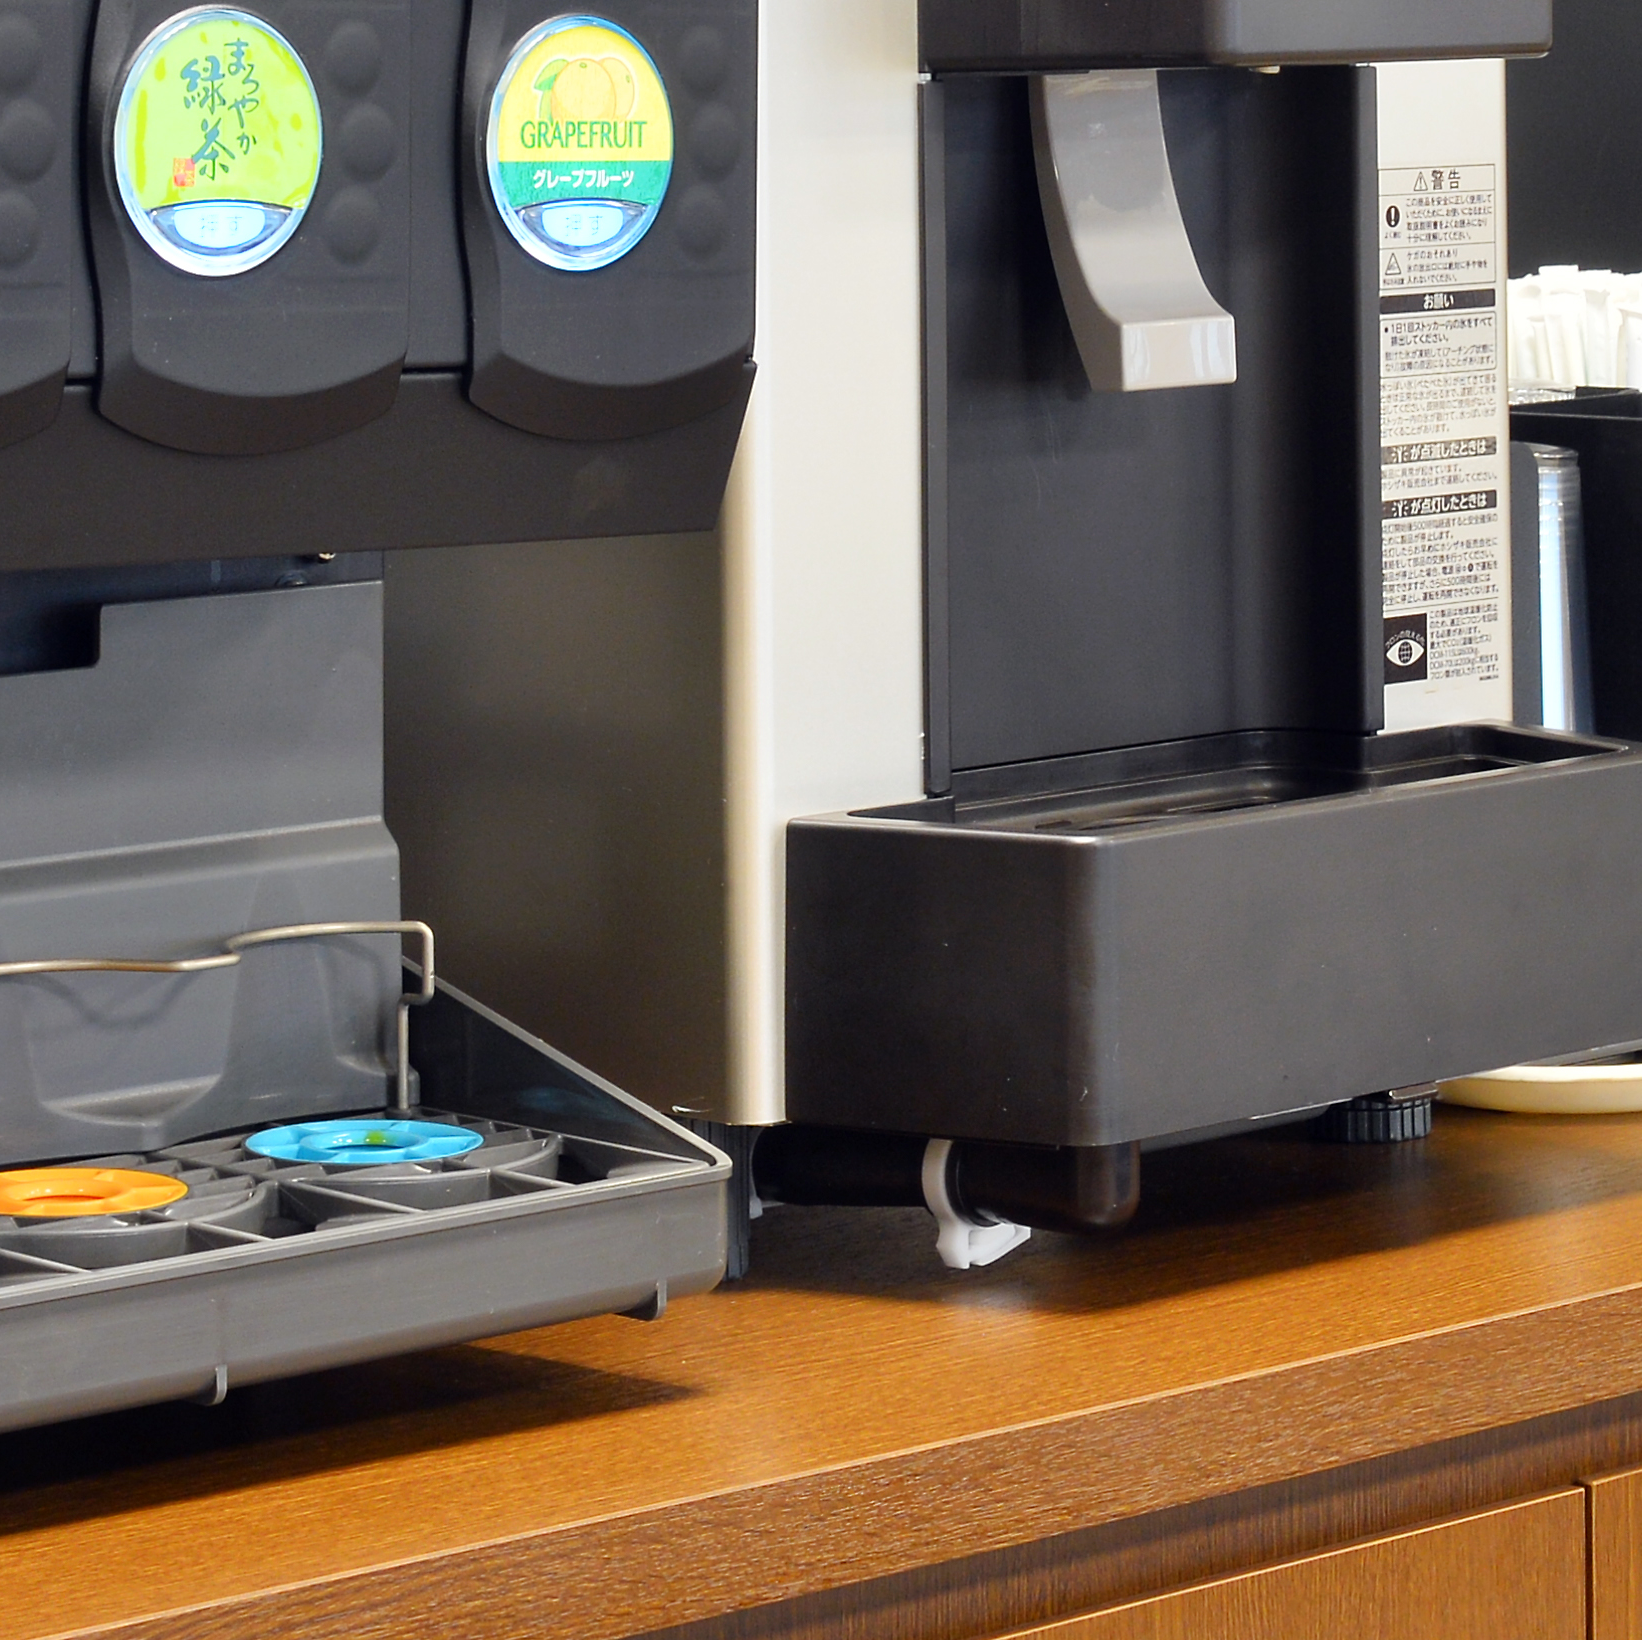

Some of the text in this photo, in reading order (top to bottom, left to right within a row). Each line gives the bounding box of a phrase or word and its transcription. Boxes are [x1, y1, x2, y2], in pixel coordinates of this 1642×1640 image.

[224, 38, 260, 155] まろやか
[180, 55, 235, 181] 緑茶
[520, 120, 647, 150] GRAPEFRUIT
[533, 168, 635, 189] グレープフルーツ
[1430, 168, 1461, 190] 警告
[1423, 293, 1454, 310] お願い
